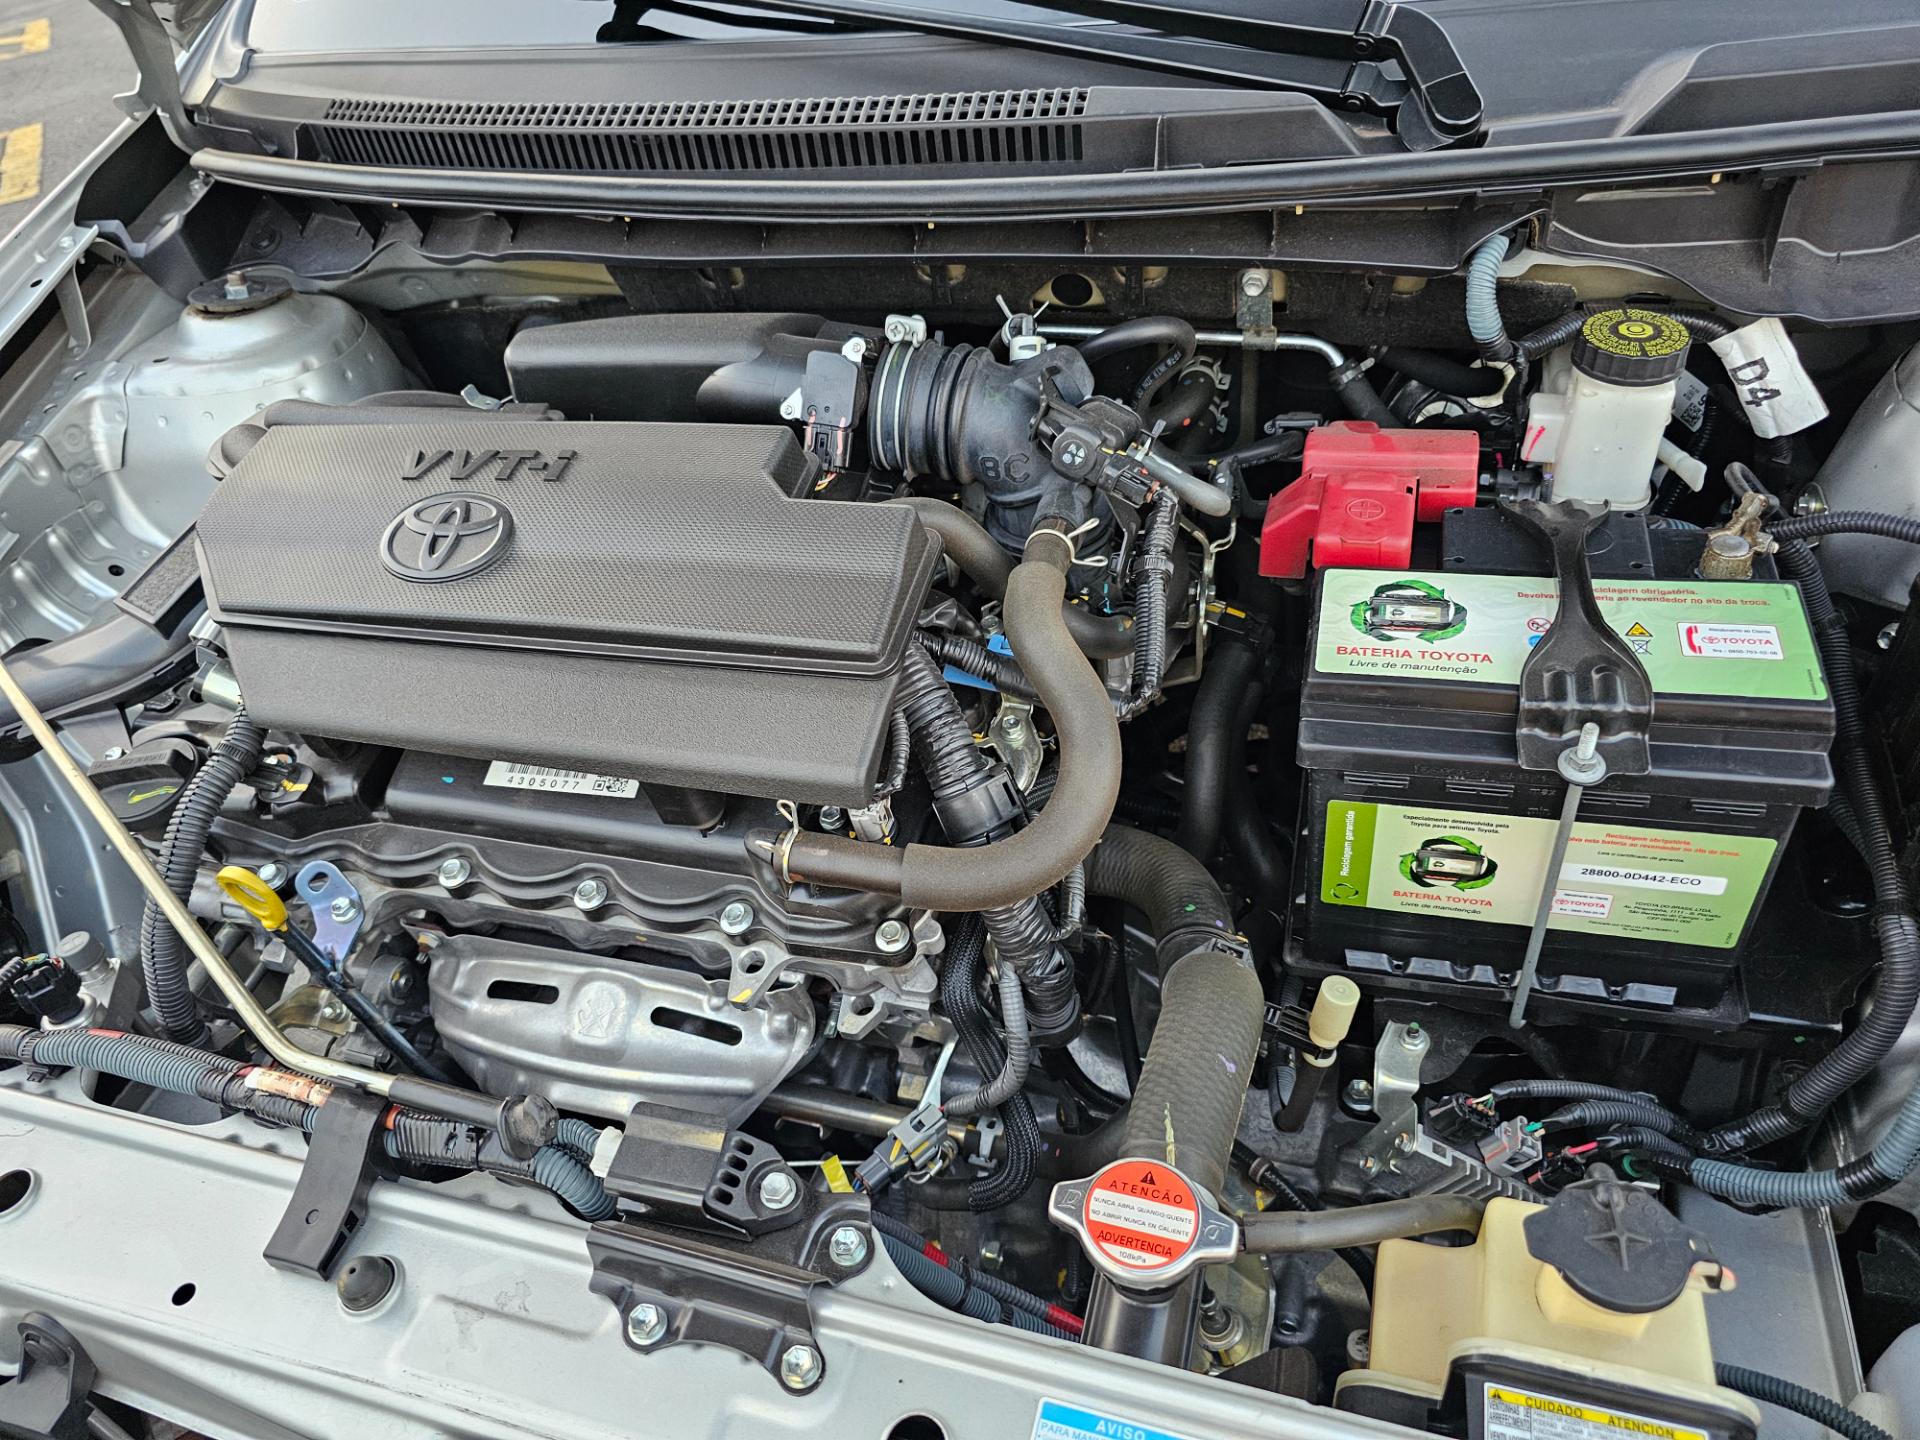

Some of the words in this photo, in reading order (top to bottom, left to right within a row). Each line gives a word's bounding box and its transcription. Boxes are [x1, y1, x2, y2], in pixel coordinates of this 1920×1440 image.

[1728, 357, 1782, 408] D4
[1517, 591, 1554, 599] Devolva
[1720, 637, 1774, 646] TOYOTA
[1336, 646, 1412, 659] BATERIA
[1418, 650, 1493, 663] TOYOTA
[1349, 659, 1379, 669] Livre
[1381, 660, 1397, 670] de
[1400, 664, 1478, 675] manutenção
[507, 776, 580, 791] 4305077
[1402, 814, 1450, 824] Especialmente
[1451, 818, 1494, 828] desenvolvida
[1410, 821, 1431, 829] Toyota
[1580, 868, 1702, 887] 28800-0D442-ECO
[1392, 890, 1442, 902] BATERIA
[1446, 895, 1493, 907] TOYOTA
[1569, 901, 1606, 909] TOYOTA
[1432, 904, 1481, 915] manutenção
[1093, 1196, 1116, 1207] NUNCA
[1123, 1216, 1146, 1227] NUNCA
[1097, 1230, 1173, 1257] ADVERTENCIA
[1525, 1397, 1583, 1419] CUIDADO
[1095, 1420, 1145, 1440] AVISO
